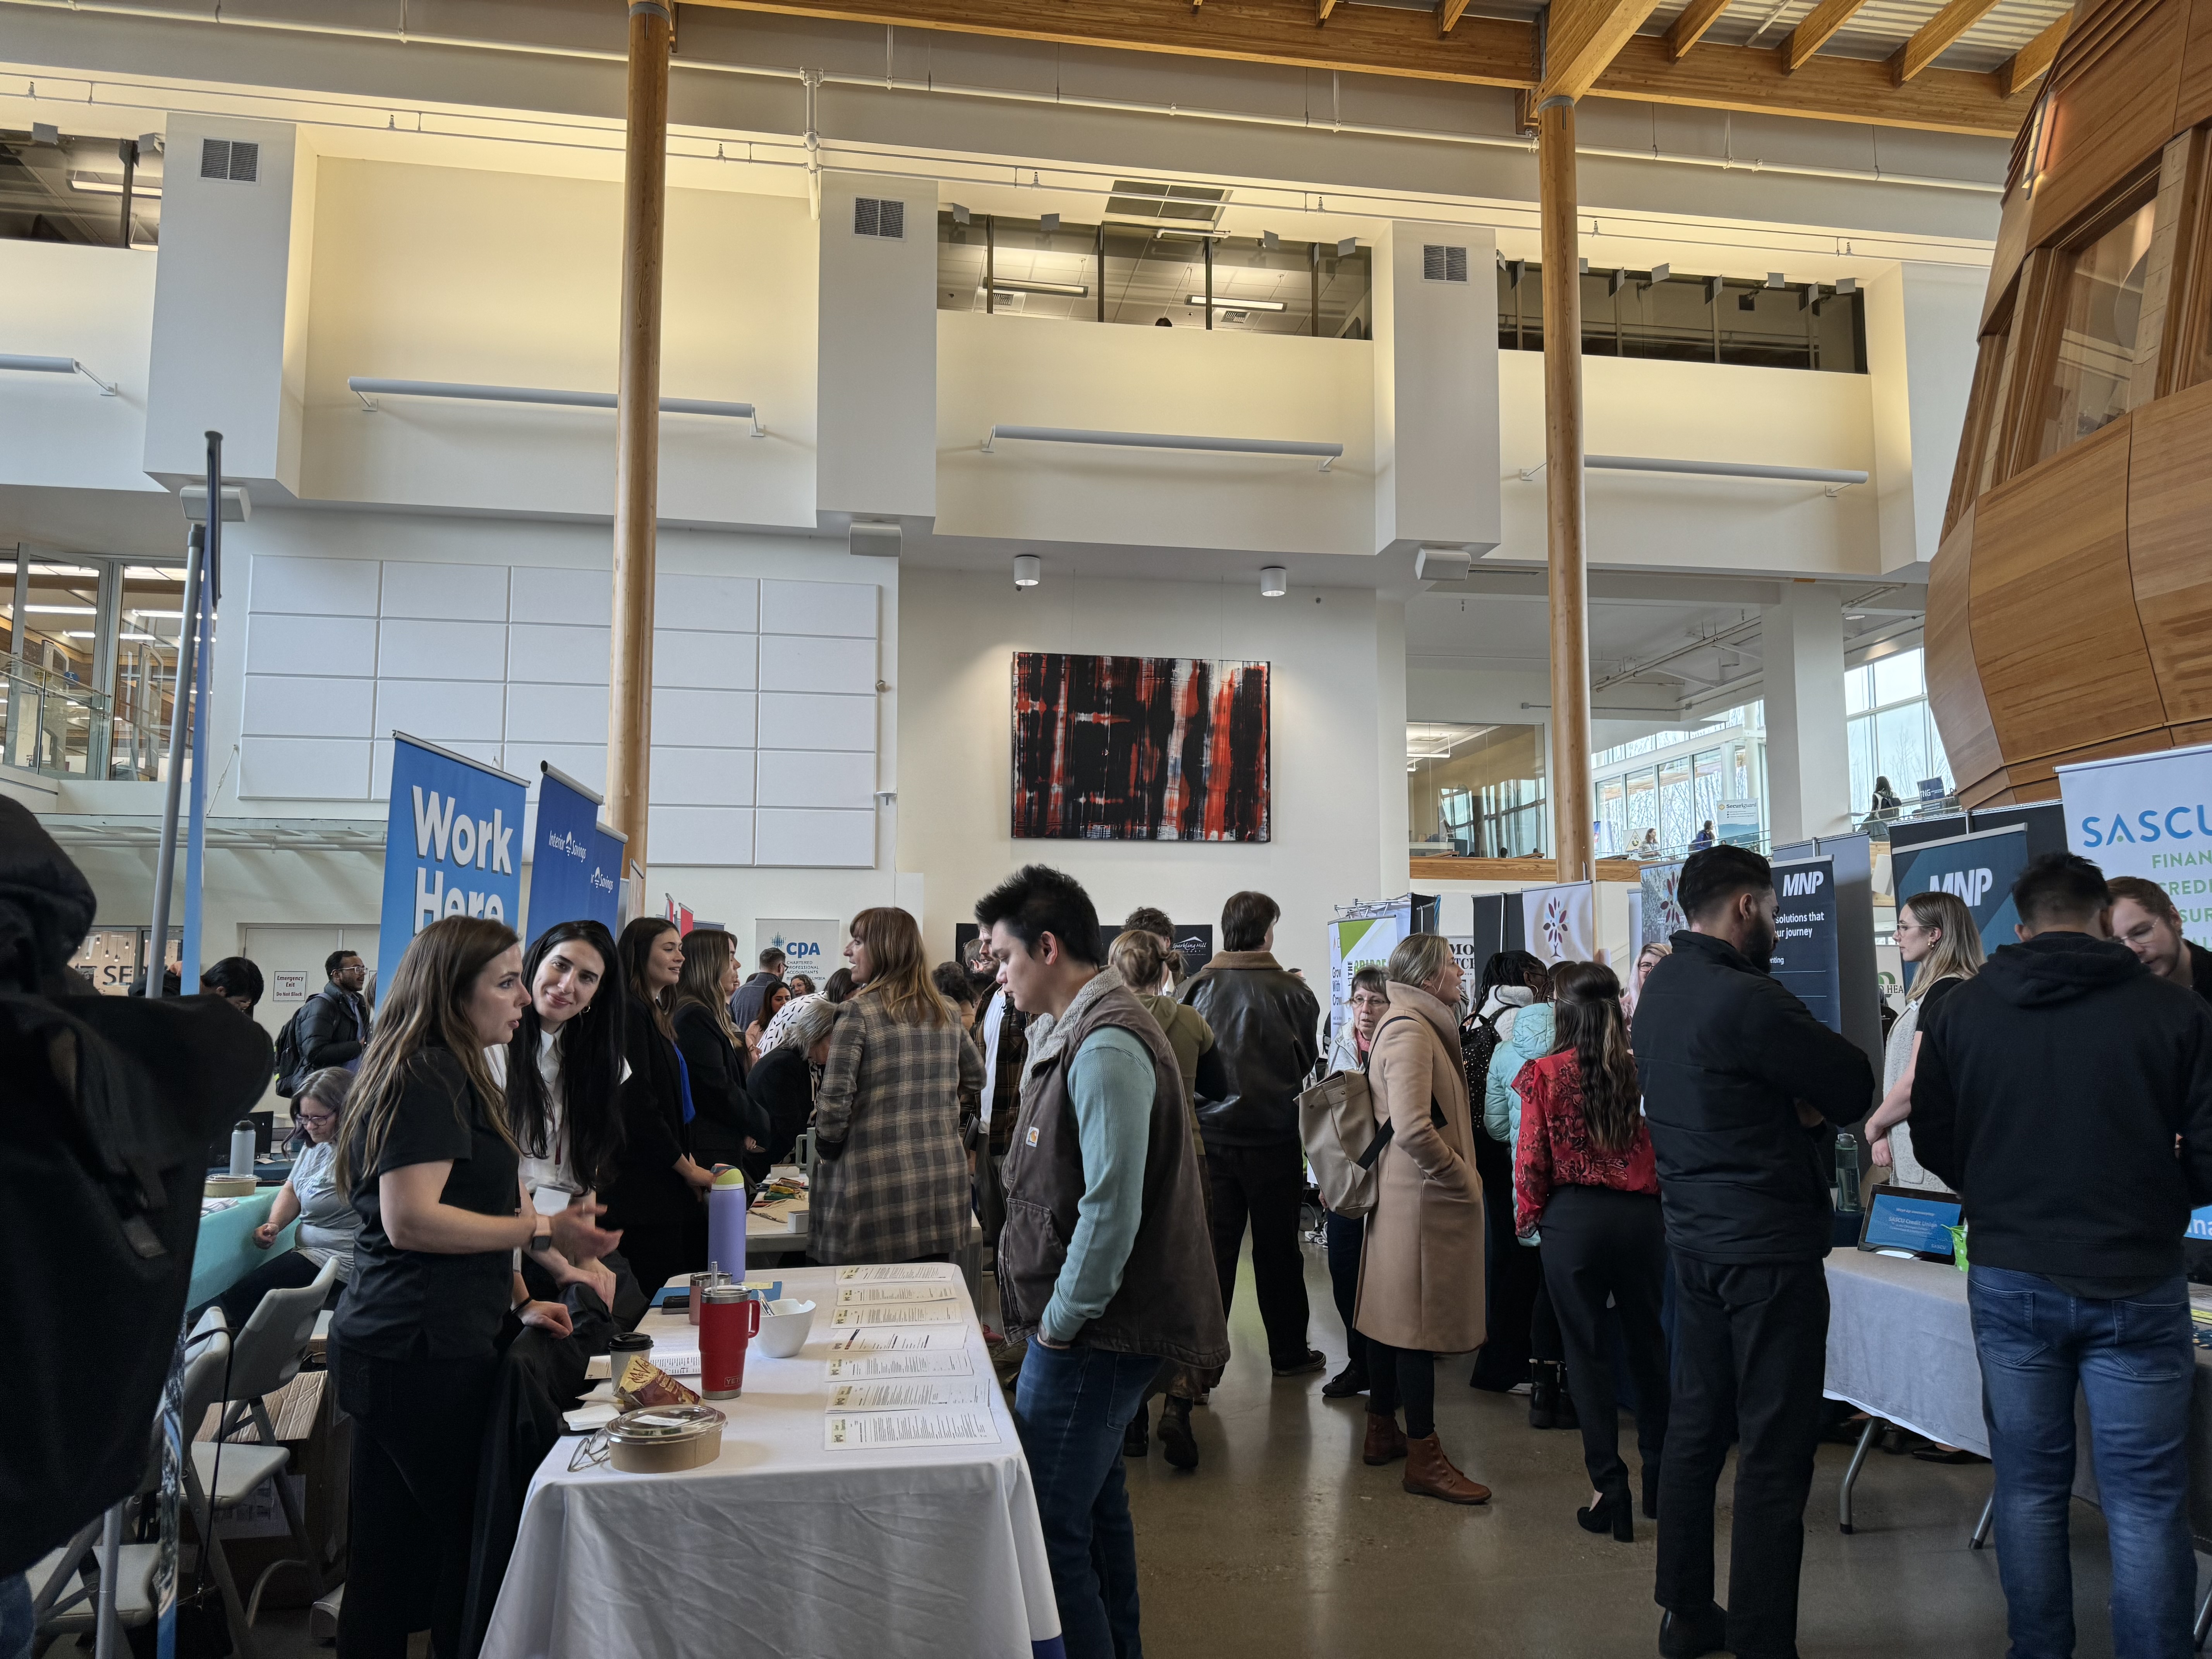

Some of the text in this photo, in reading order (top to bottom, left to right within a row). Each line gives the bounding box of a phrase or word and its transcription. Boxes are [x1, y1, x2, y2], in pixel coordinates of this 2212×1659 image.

[412, 785, 514, 874] Work
[2082, 805, 2212, 848] SASCU
[549, 830, 586, 863] Interior Savings
[2152, 850, 2212, 868] FINAN
[599, 874, 613, 893] Savings
[1783, 871, 1824, 897] MNP
[1929, 868, 1993, 907] MNP
[414, 867, 504, 934] Here
[1776, 912, 1824, 924] solutions that
[1172, 942, 1196, 950] Sparkling
[1785, 928, 1813, 939] journey
